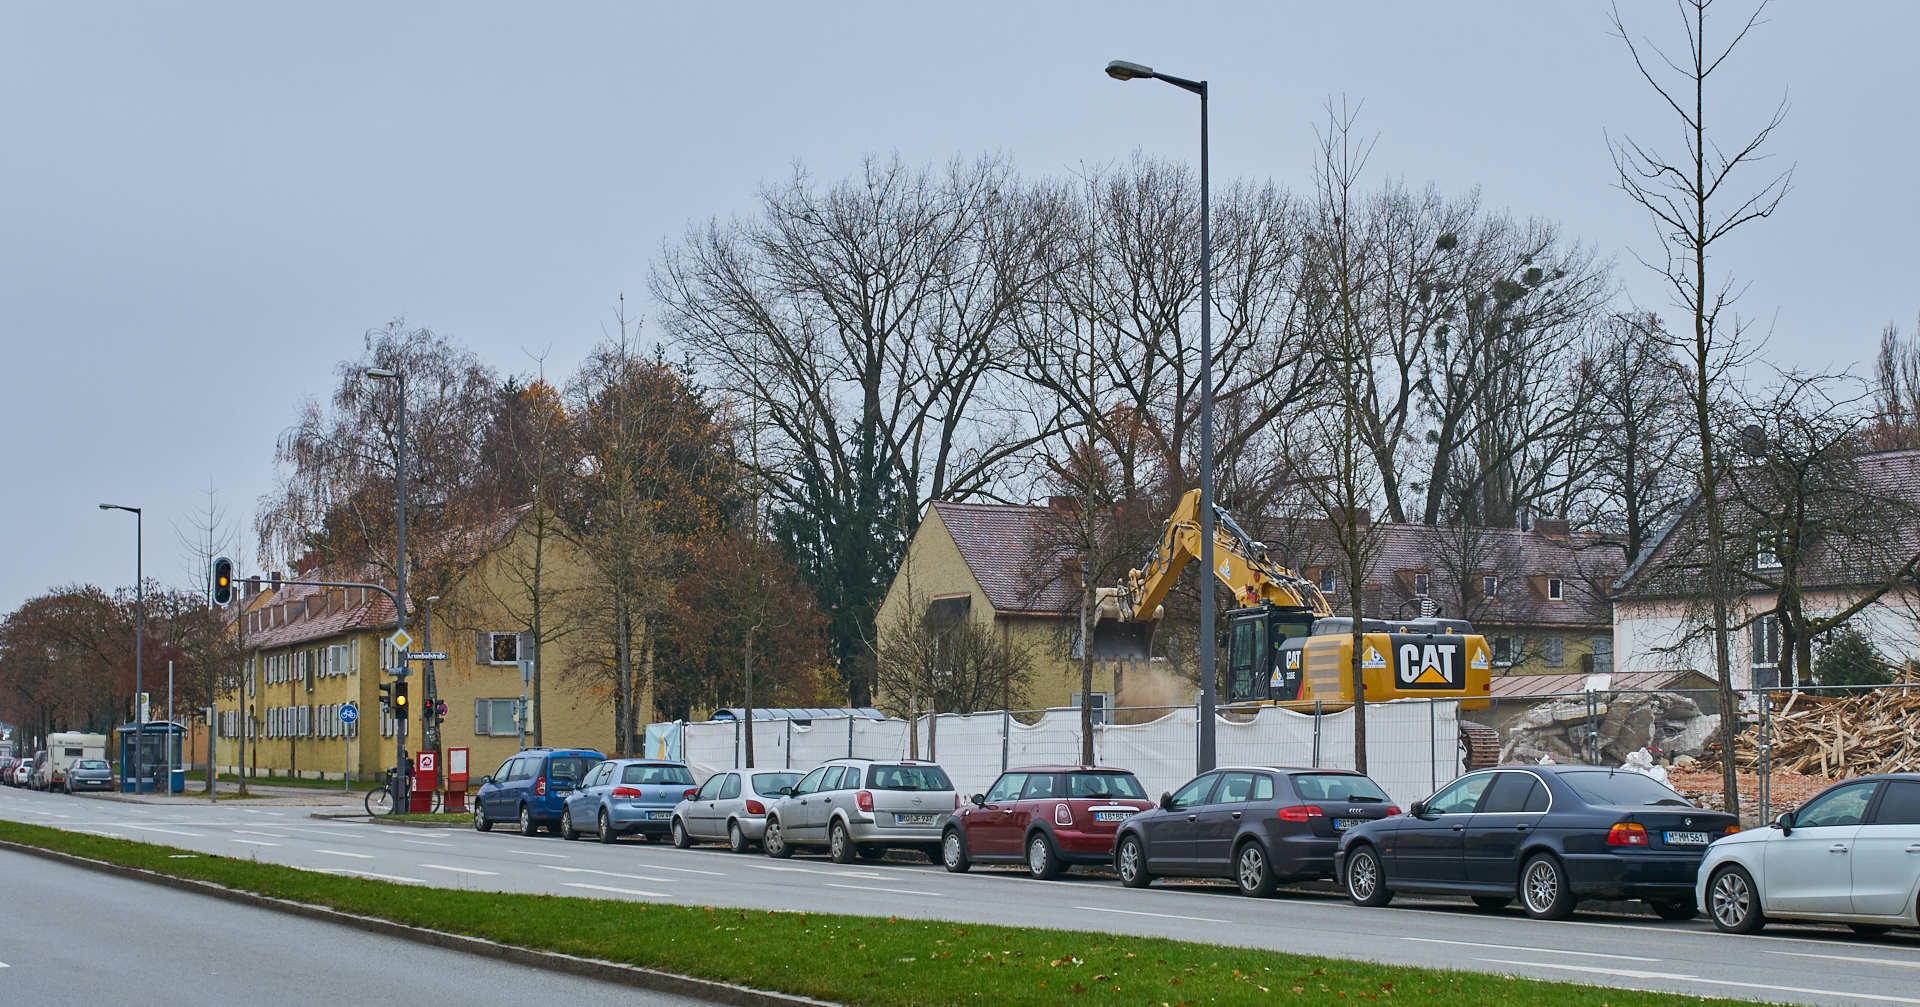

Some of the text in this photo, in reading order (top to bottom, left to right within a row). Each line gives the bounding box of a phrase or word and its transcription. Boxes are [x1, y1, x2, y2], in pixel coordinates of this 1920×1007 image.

[1286, 651, 1301, 669] CAT
[1399, 643, 1456, 683] CAT
[1668, 832, 1704, 842] M MM 561
